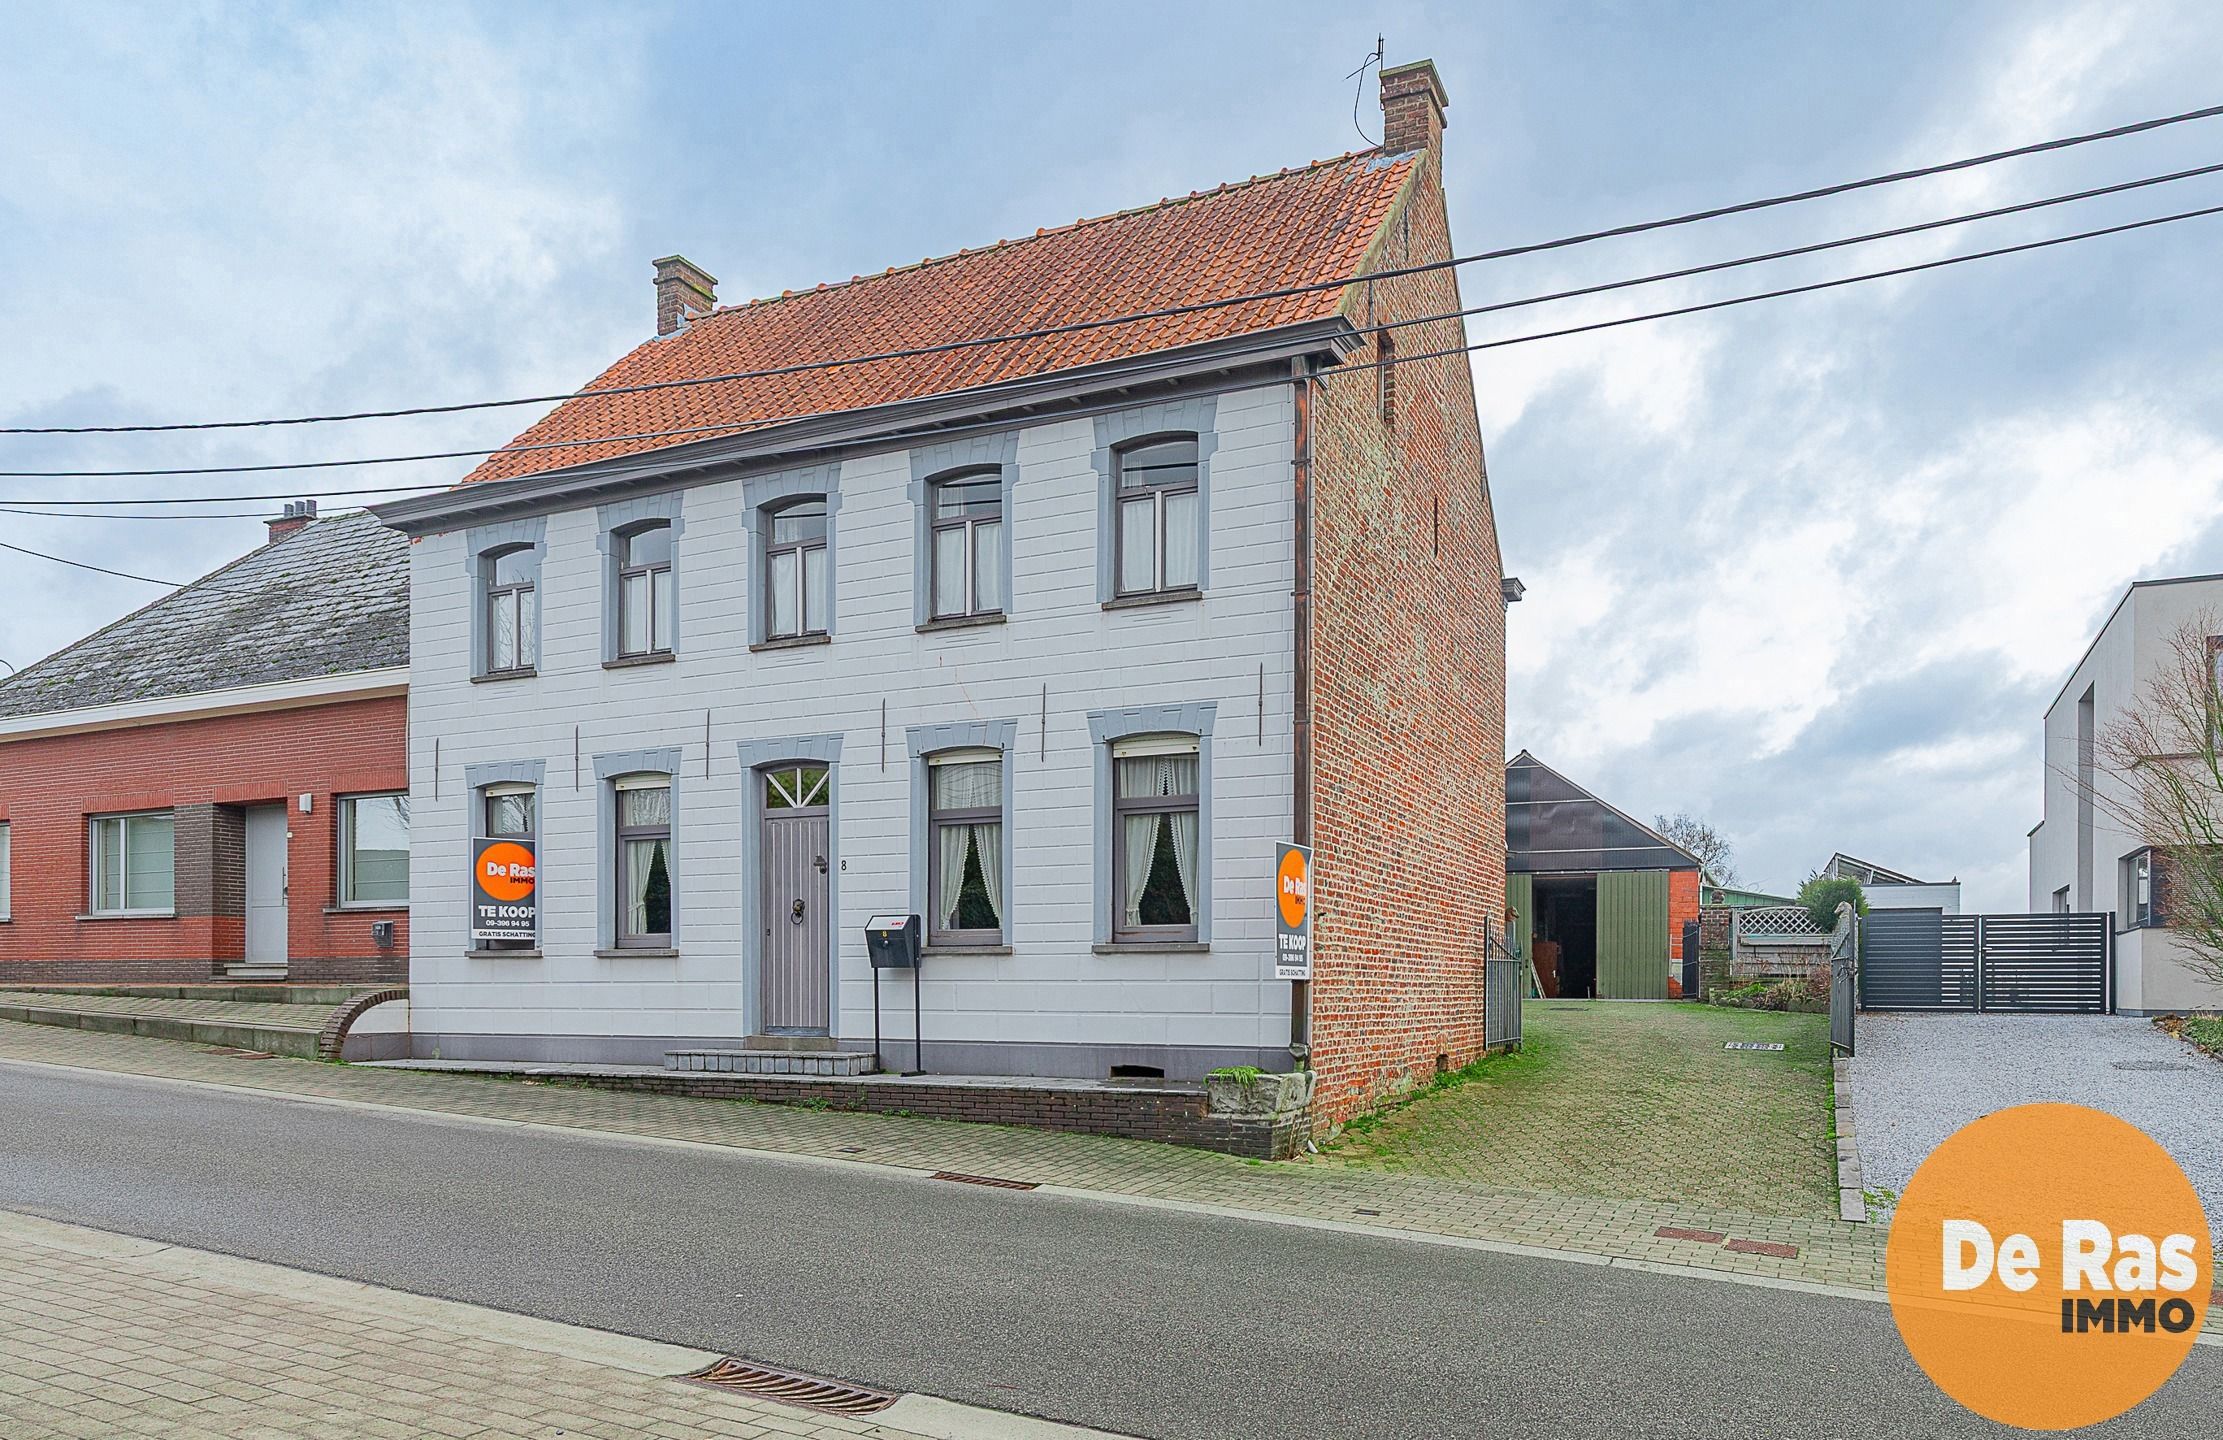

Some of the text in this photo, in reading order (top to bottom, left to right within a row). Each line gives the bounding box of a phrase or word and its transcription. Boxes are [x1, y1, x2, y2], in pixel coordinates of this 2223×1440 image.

[487, 862, 535, 877] De Ras
[841, 860, 847, 871] 8
[1284, 875, 1294, 895] De
[478, 905, 535, 918] TE KOOP
[1279, 934, 1306, 950] TE KOOP
